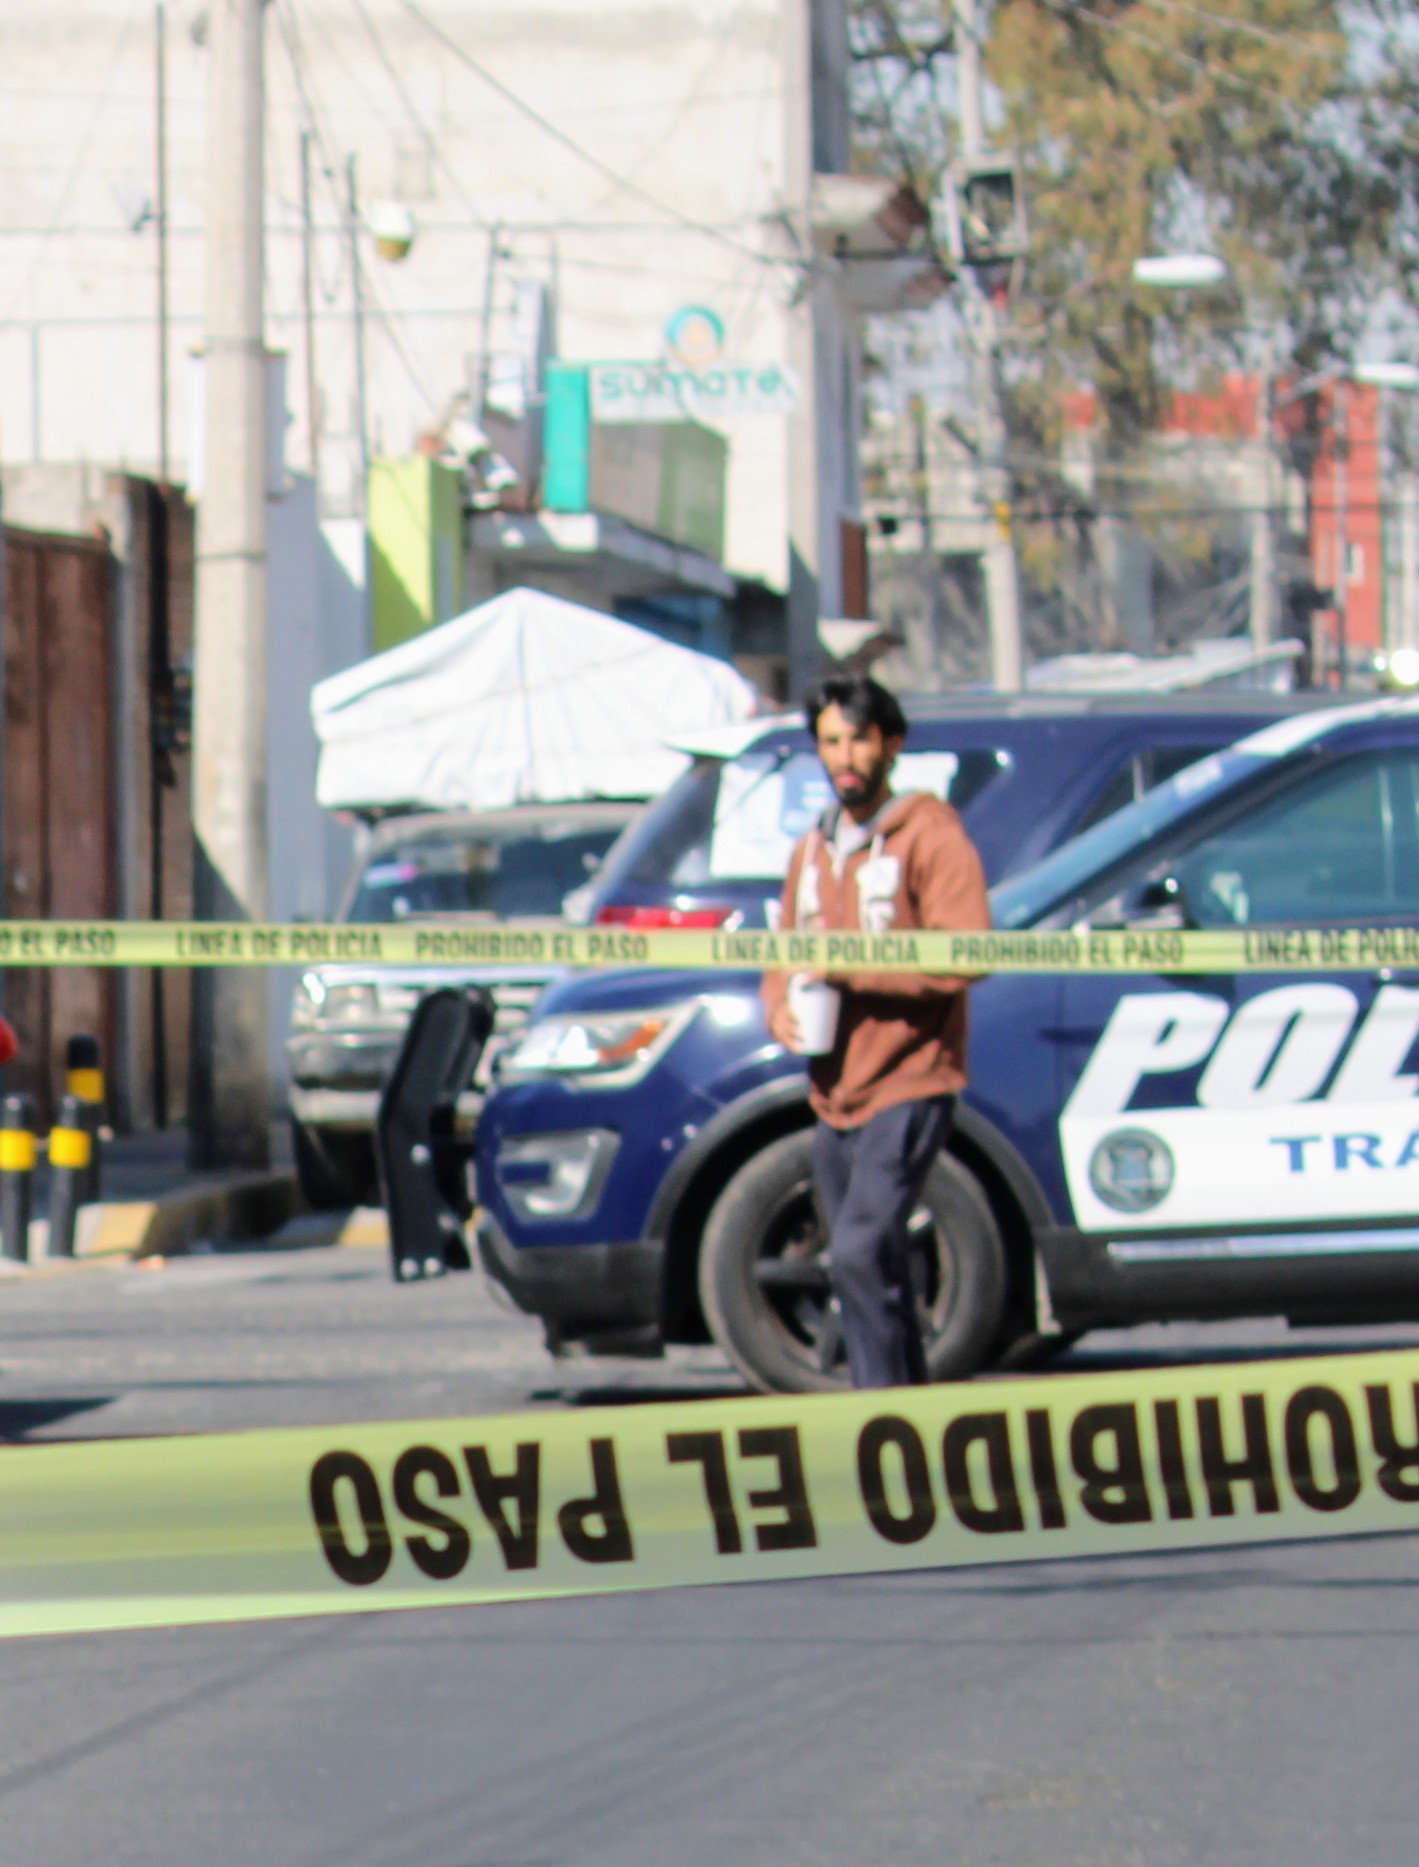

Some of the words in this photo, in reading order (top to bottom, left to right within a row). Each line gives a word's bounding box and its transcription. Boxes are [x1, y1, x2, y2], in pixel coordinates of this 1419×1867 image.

[20, 929, 46, 956] EL
[56, 930, 116, 957] PASO
[176, 930, 246, 957] LINEA
[252, 931, 282, 957] DE
[290, 932, 382, 957] POLICIA
[415, 932, 543, 959] PROHIBIDO
[553, 933, 580, 959] EL
[588, 933, 649, 960] PASO
[712, 935, 779, 961] LINEA
[788, 935, 817, 962] DE
[827, 936, 920, 962] POLICIA
[951, 937, 1079, 964] PROHIBIDO
[1089, 937, 1116, 963] EL
[1123, 937, 1184, 963] PASO
[1243, 934, 1311, 962] LINEA
[1320, 933, 1348, 961] DE
[309, 1436, 634, 1586] PASO
[667, 1425, 818, 1555] EL
